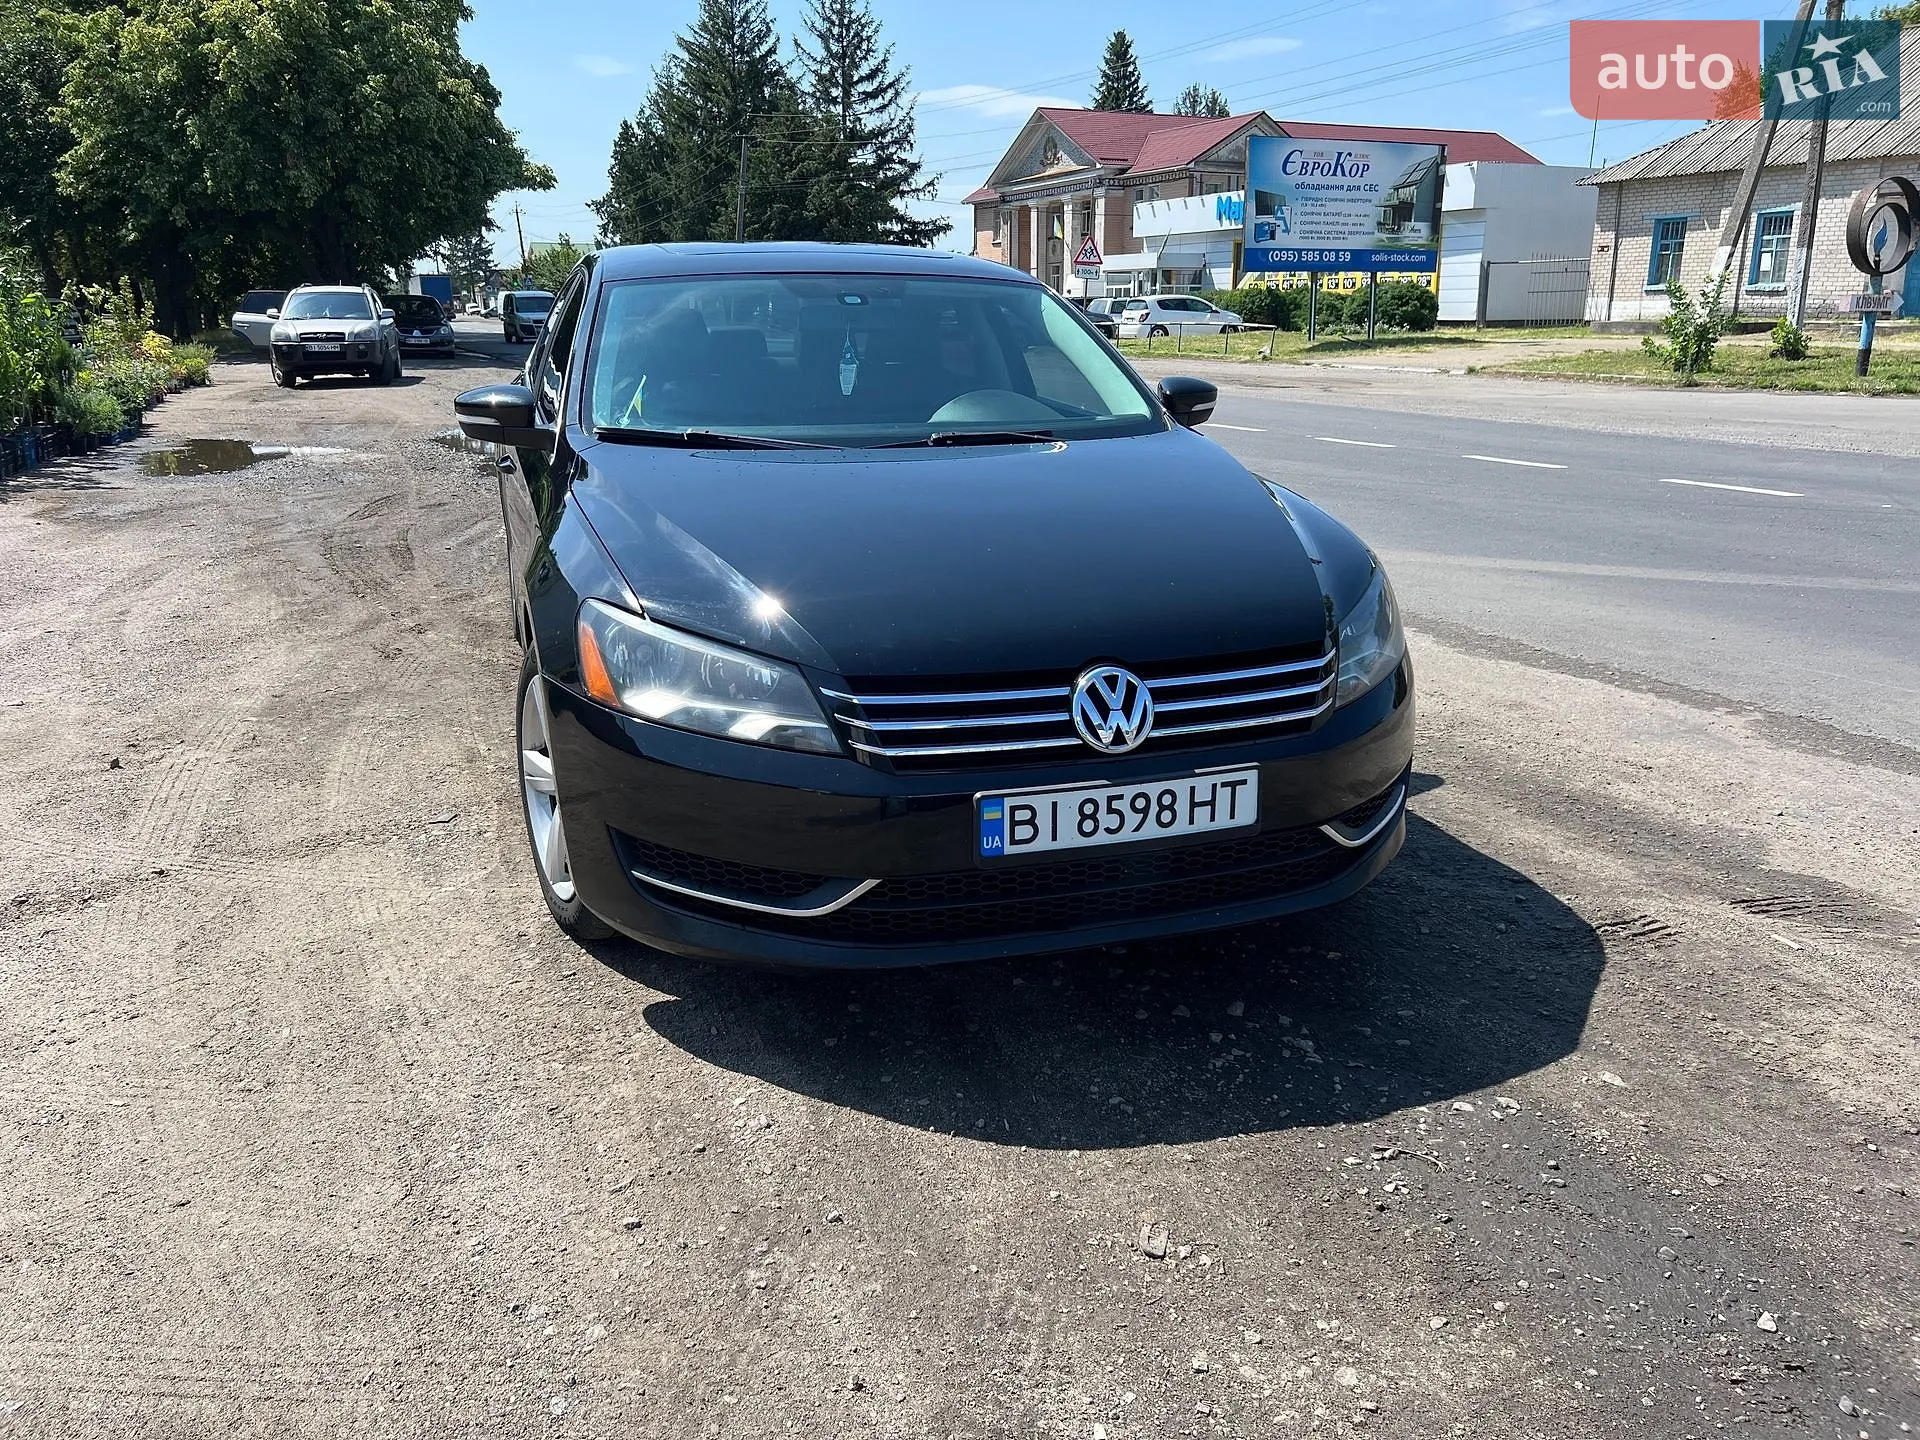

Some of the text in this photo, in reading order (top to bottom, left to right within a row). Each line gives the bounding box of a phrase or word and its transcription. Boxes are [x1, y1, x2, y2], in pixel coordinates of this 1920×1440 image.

[1294, 181, 1379, 193] обладнання для СЕС
[1268, 250, 1351, 263] (095) 585 08 59
[1371, 252, 1427, 262] solis-stock.com
[1008, 778, 1248, 847] BI 8598 HT
[983, 835, 1001, 849] UA
